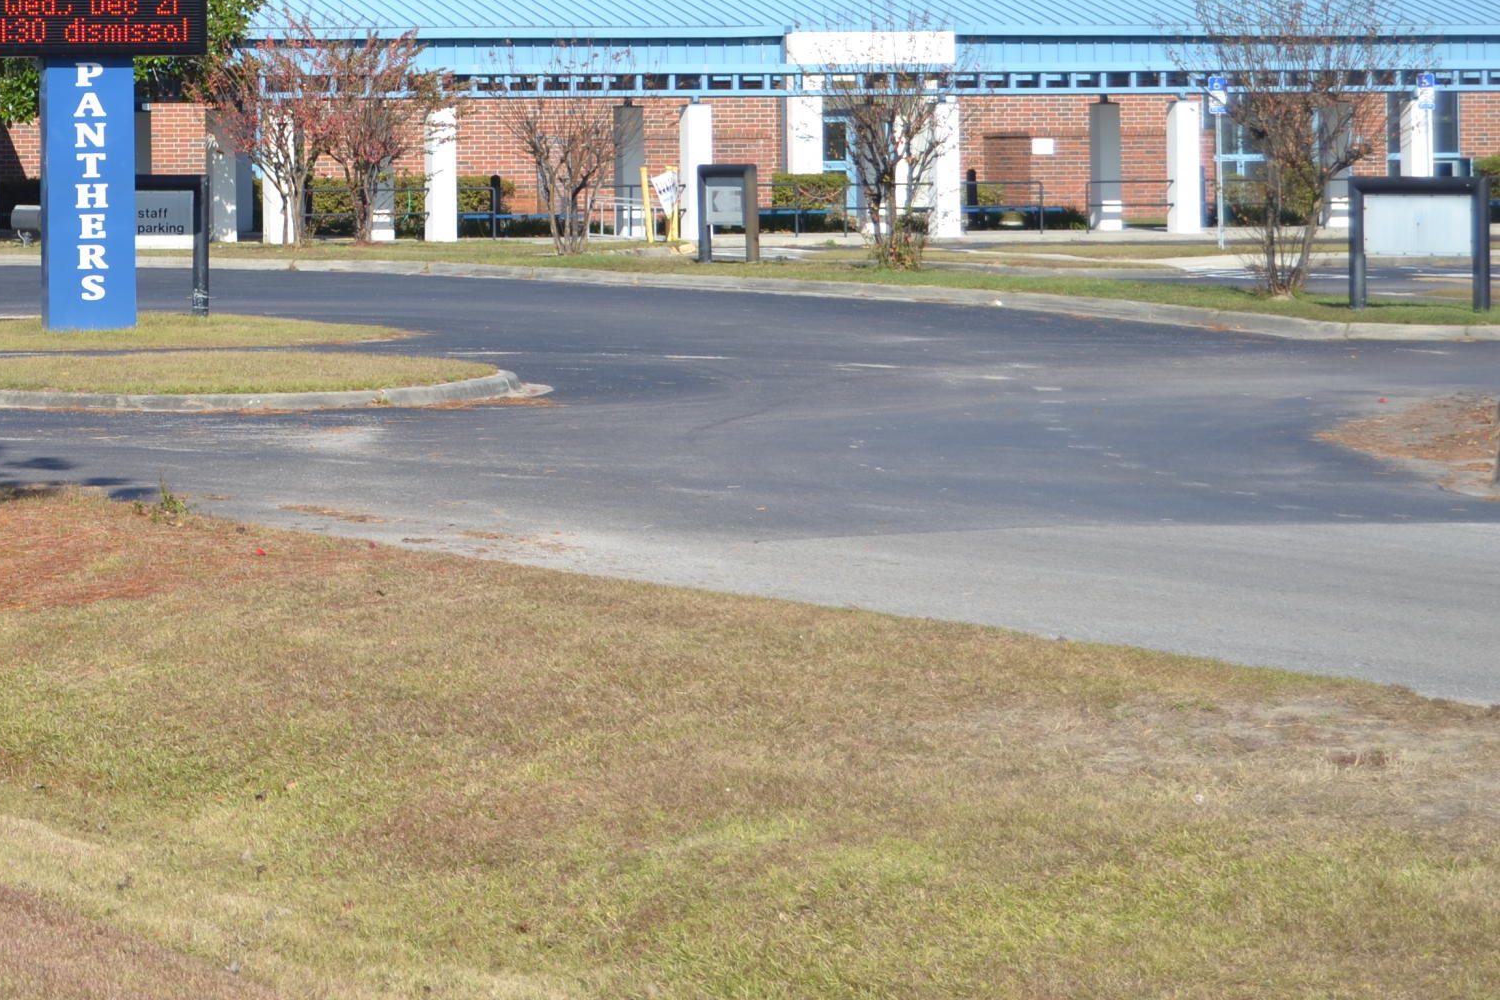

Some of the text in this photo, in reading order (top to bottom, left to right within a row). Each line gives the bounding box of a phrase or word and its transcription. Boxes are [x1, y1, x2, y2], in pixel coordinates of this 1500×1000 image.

[63, 17, 190, 43] dismissal
[73, 62, 109, 301] PANTHERS
[137, 207, 168, 219] staff
[137, 222, 185, 236] parking
